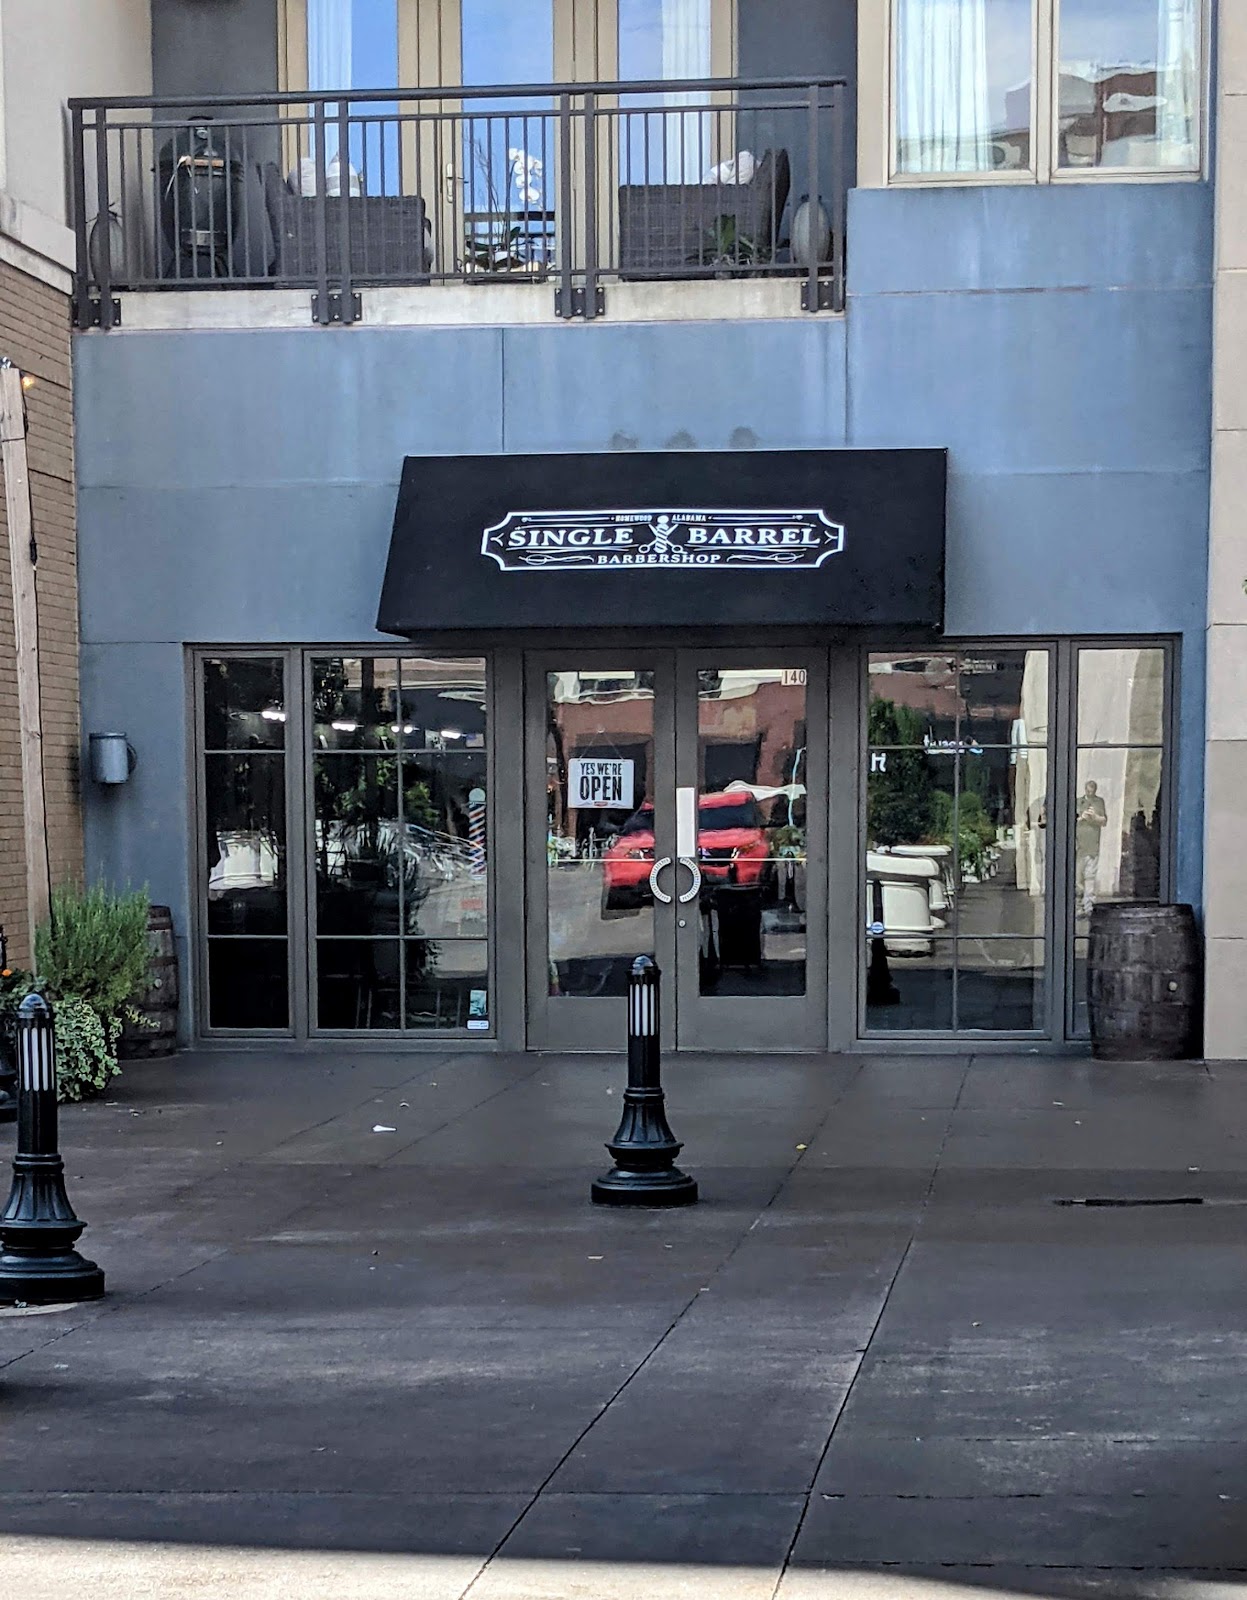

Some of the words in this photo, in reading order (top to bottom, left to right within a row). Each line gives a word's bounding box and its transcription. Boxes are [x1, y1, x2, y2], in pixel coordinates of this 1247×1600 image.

[615, 514, 652, 522] HOMEWOOD
[671, 514, 706, 522] ALABAMA
[508, 527, 634, 547] SINGLE
[687, 526, 820, 545] BARREL
[596, 553, 721, 564] BARBERSHOP
[783, 670, 806, 684] 140
[580, 762, 595, 775] YES
[597, 762, 622, 775] WE'RE
[579, 775, 622, 801] OPEN
